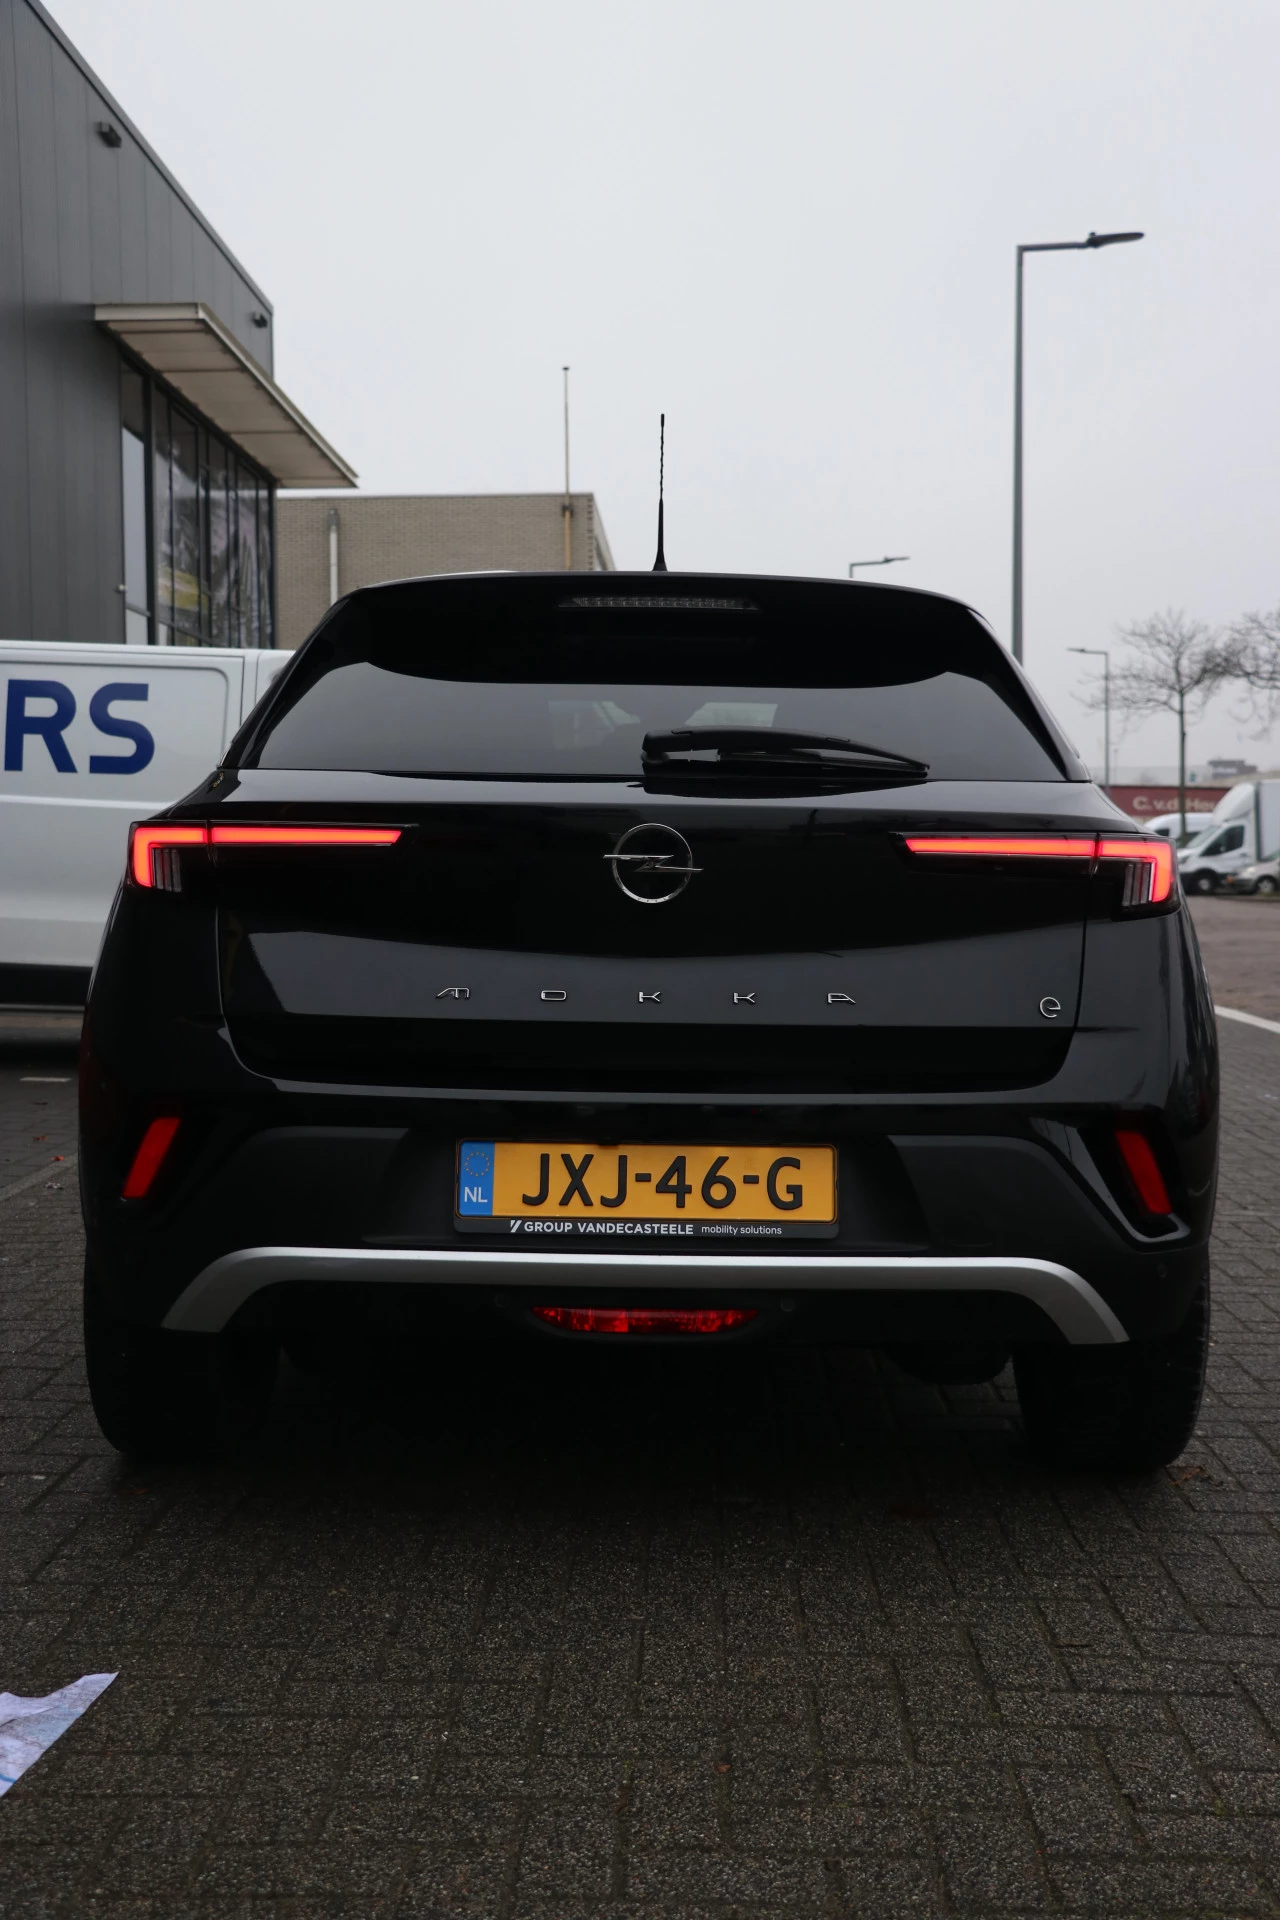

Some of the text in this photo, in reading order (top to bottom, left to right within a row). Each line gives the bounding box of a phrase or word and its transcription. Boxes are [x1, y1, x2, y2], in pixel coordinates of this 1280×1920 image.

[4, 679, 155, 775] RS
[433, 987, 857, 1004] MOKKA
[1039, 996, 1061, 1018] e
[522, 1153, 803, 1210] JXJ-46-G
[463, 1186, 488, 1203] NL
[524, 1221, 782, 1235] GROUP VANDECASTEELE mobility solutions
